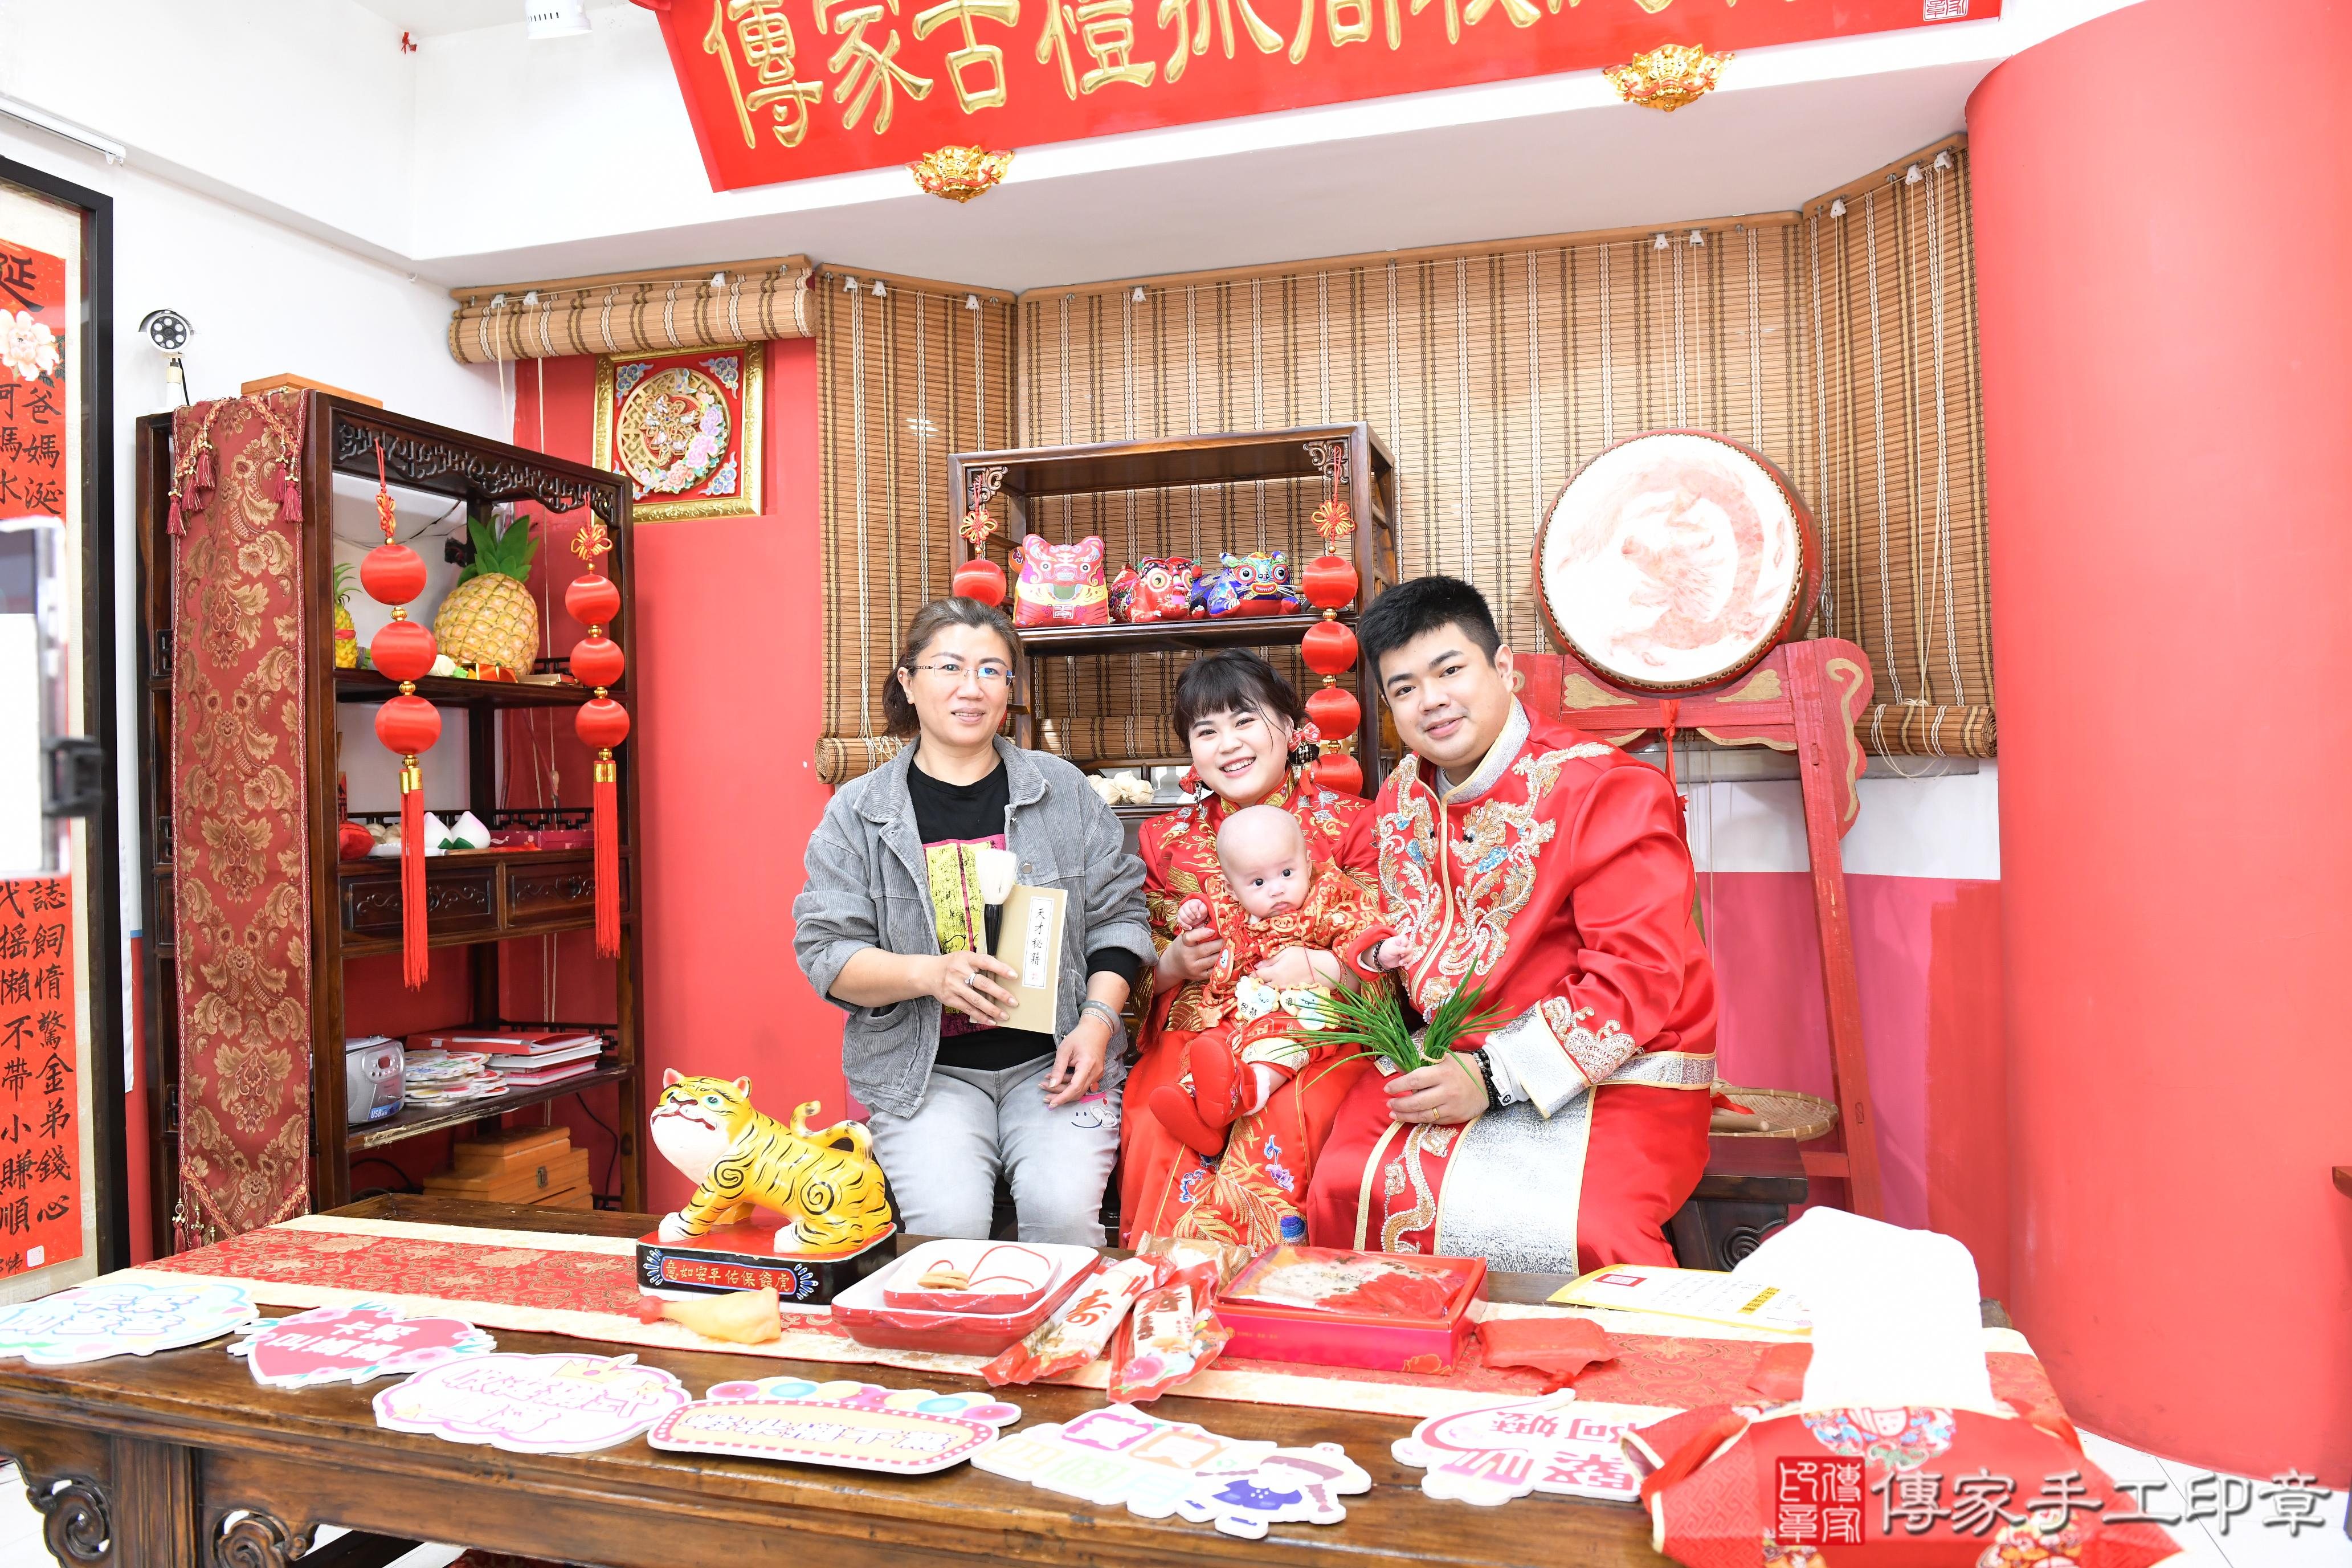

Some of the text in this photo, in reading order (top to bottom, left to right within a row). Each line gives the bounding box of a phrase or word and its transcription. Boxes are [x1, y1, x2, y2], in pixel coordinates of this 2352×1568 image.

[1030, 908, 1046, 966] 天才秘籍
[370, 1108, 382, 1119] USB
